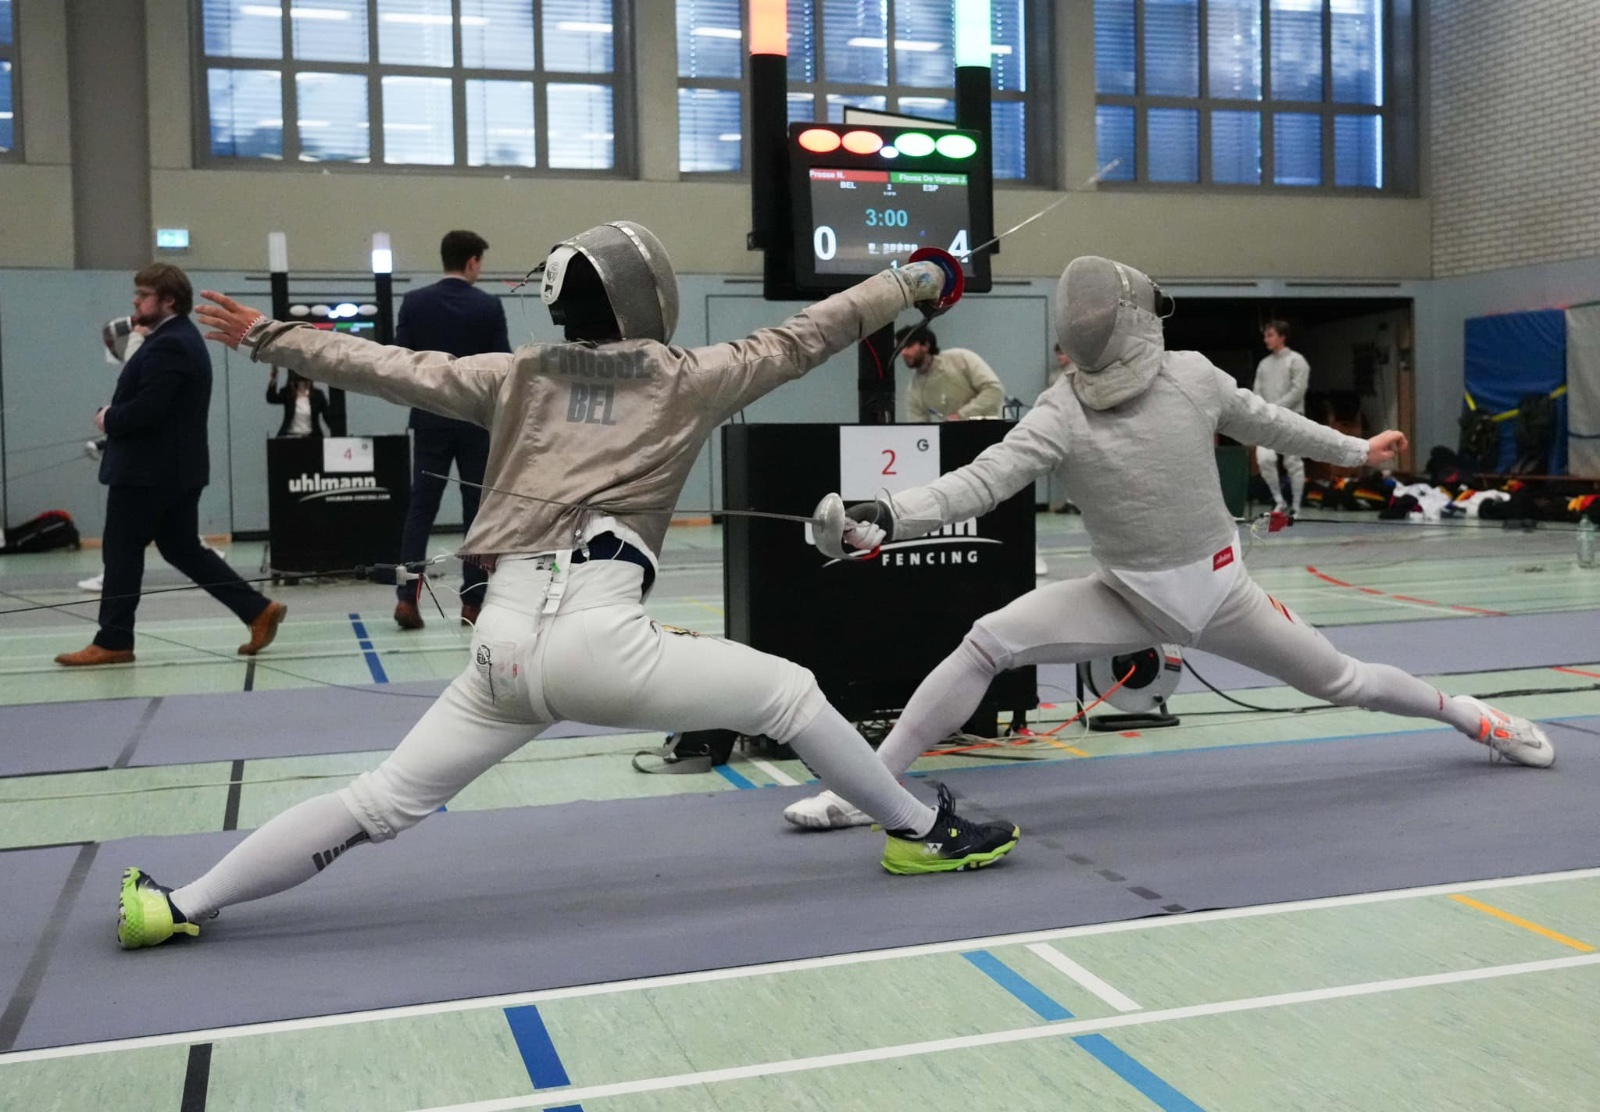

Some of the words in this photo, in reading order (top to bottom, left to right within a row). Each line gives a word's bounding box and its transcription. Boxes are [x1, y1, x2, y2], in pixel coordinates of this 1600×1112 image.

[840, 181, 857, 189] BEL
[865, 208, 908, 227] 3:00
[813, 225, 837, 261] 0
[948, 229, 972, 263] 4
[566, 382, 617, 425] BEL
[344, 447, 353, 460] 4
[917, 438, 930, 452] G
[881, 449, 897, 476] 2
[288, 472, 377, 493] uhlmann
[882, 550, 978, 566] FENCING
